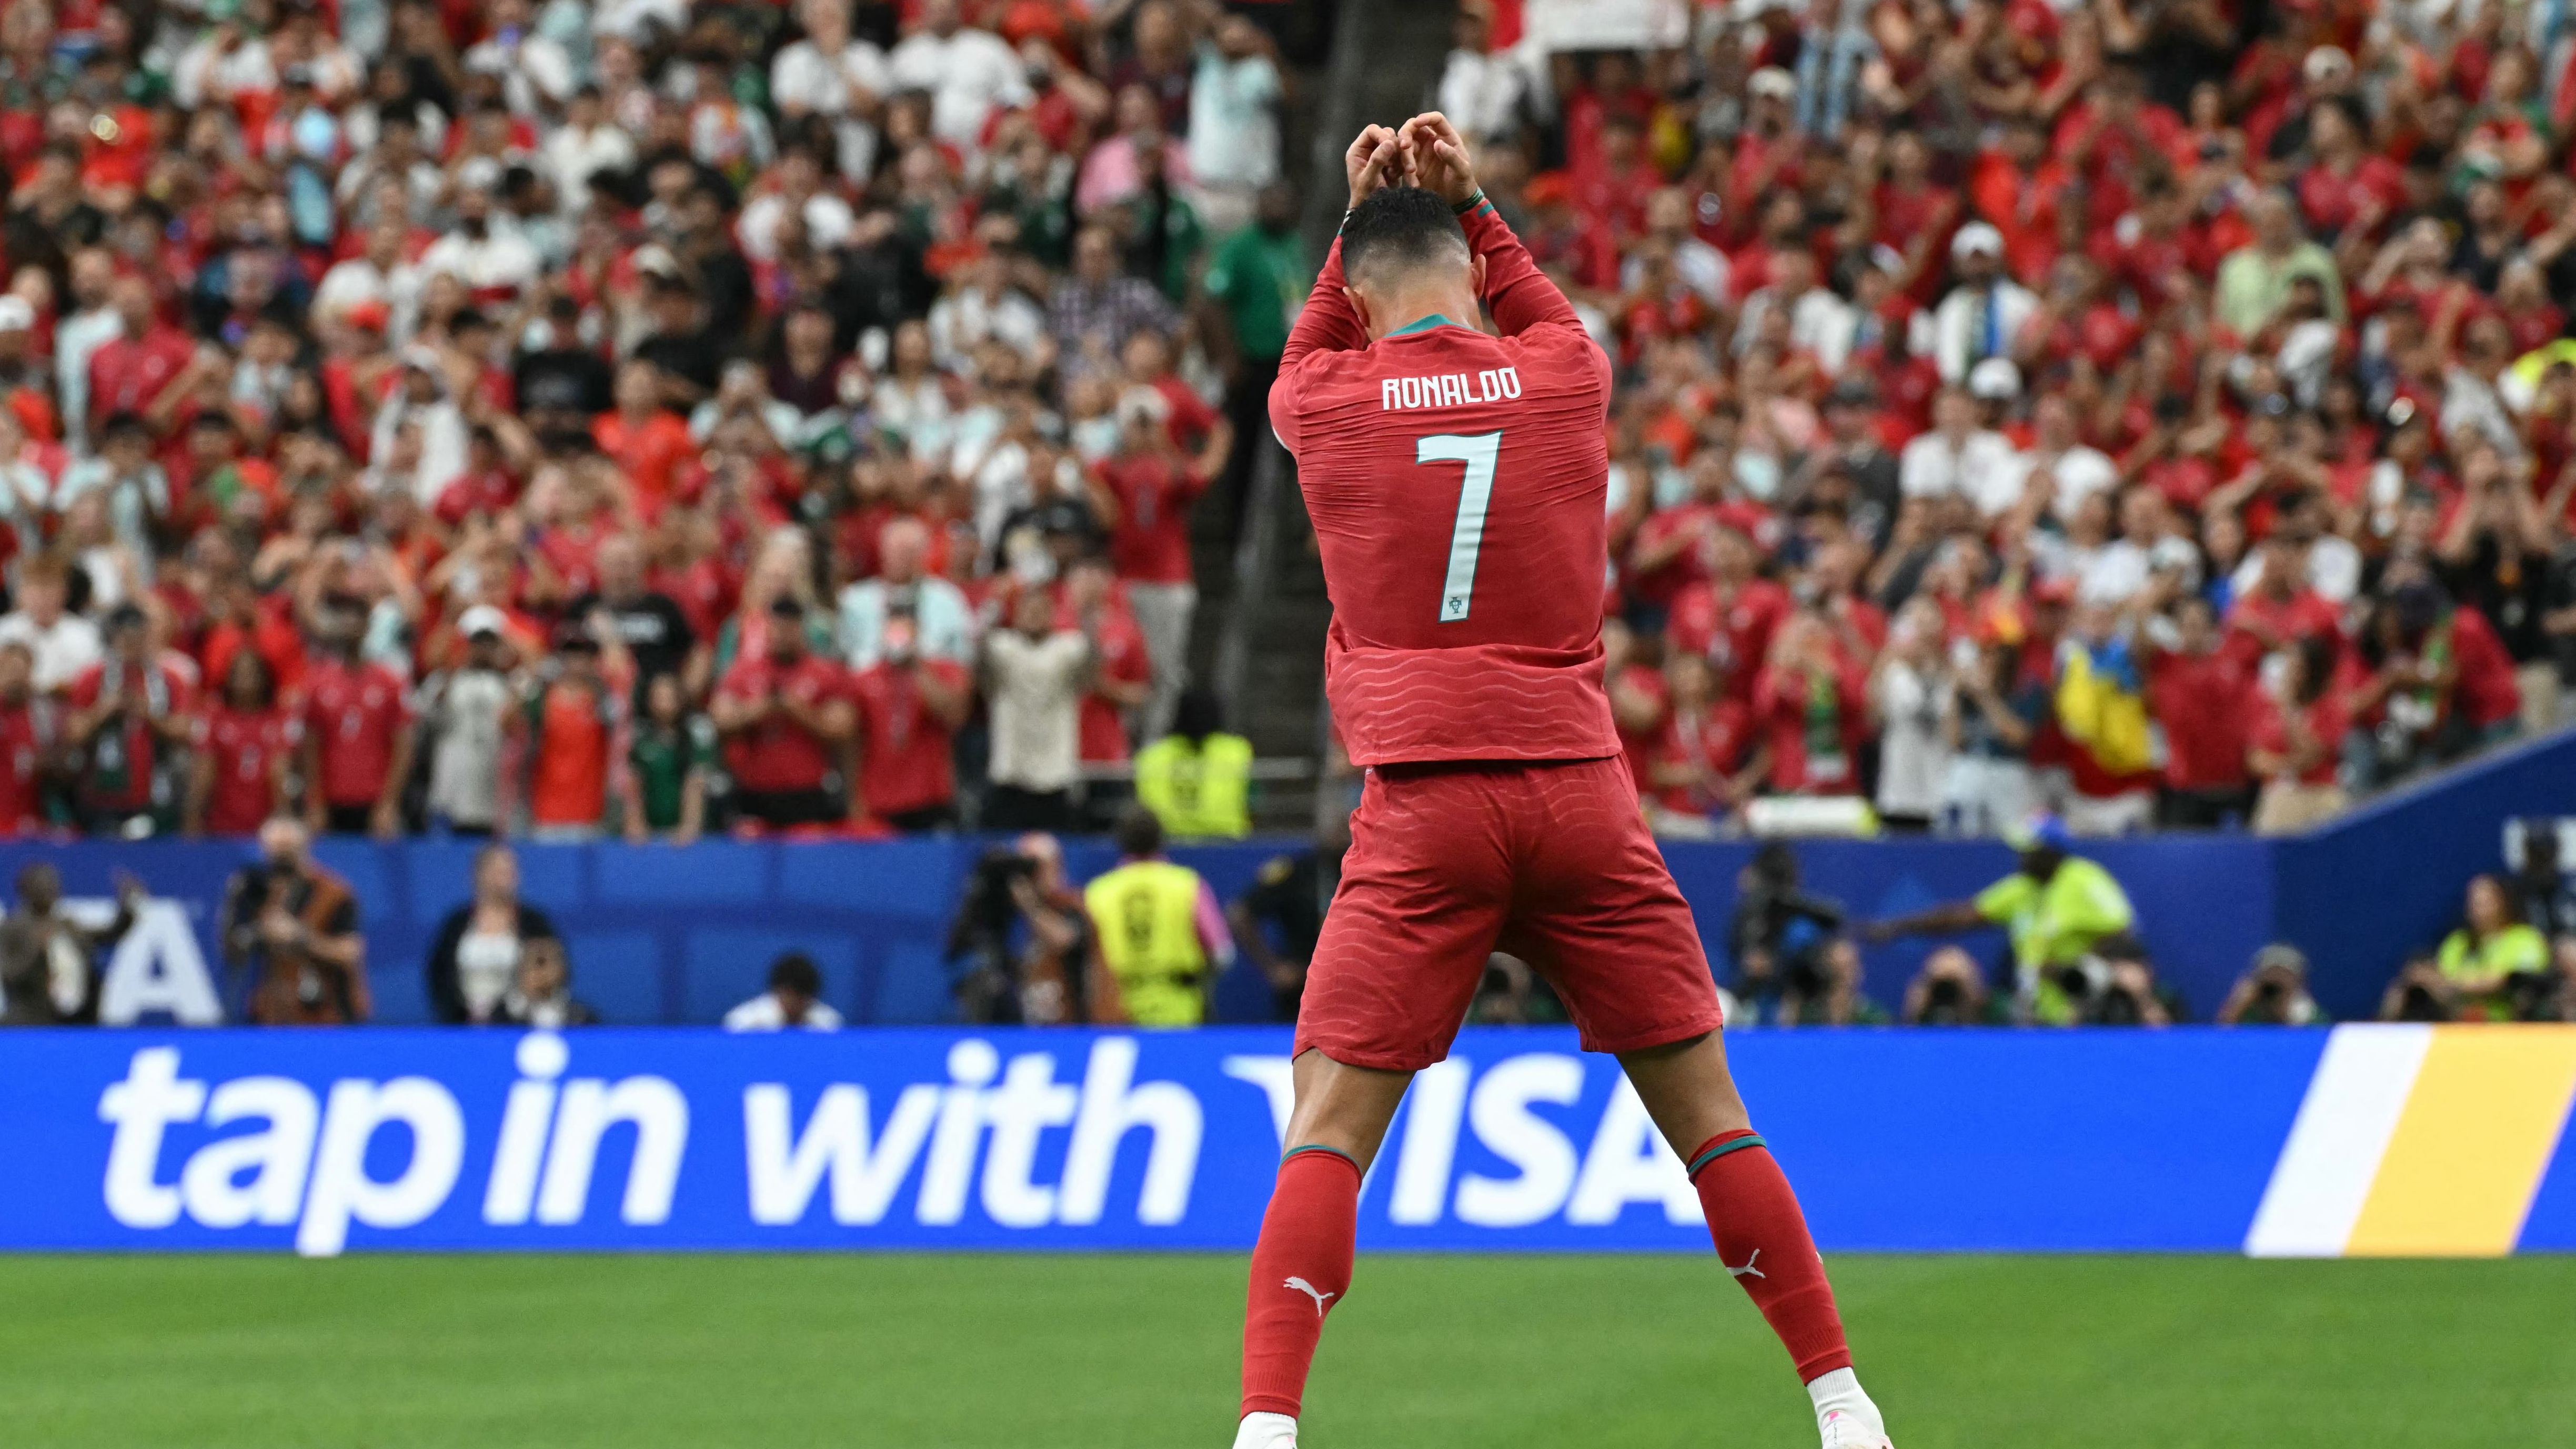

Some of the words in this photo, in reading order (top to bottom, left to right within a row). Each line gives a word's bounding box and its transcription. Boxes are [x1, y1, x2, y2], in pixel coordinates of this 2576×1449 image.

[1382, 366, 1522, 410] RONALDO
[1416, 430, 1503, 623] 7
[99, 1047, 465, 1257] tap
[483, 1030, 689, 1226] in
[743, 1037, 1203, 1227] with
